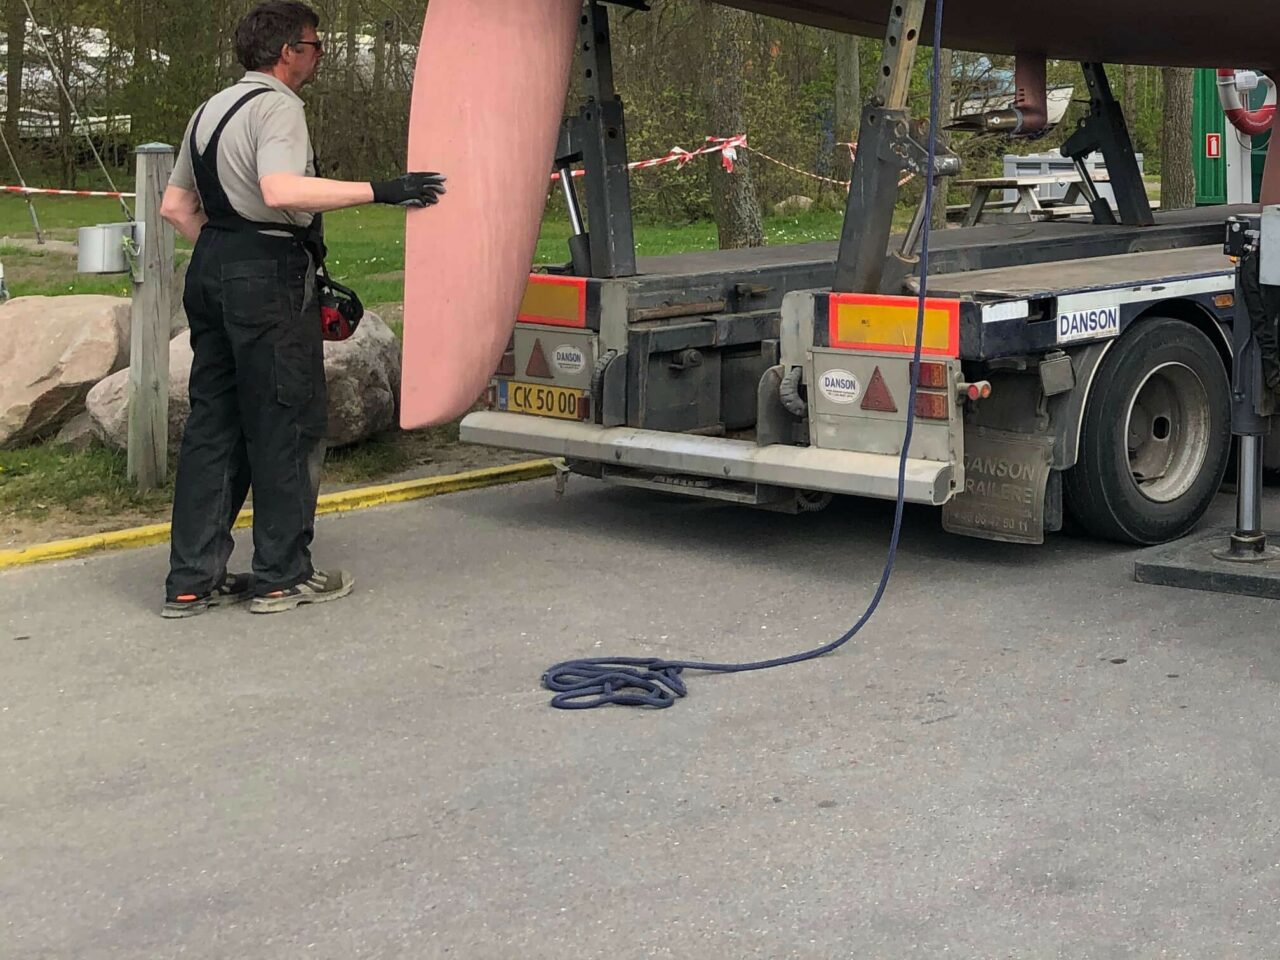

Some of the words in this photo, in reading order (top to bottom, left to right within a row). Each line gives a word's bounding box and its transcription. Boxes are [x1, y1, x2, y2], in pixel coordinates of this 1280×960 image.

[1060, 308, 1117, 336] DANSON
[556, 351, 582, 363] DANSON
[824, 376, 856, 390] DANSON
[513, 386, 533, 410] CK
[536, 389, 555, 412] 50
[558, 391, 577, 415] 00
[965, 457, 1035, 482] ANSON
